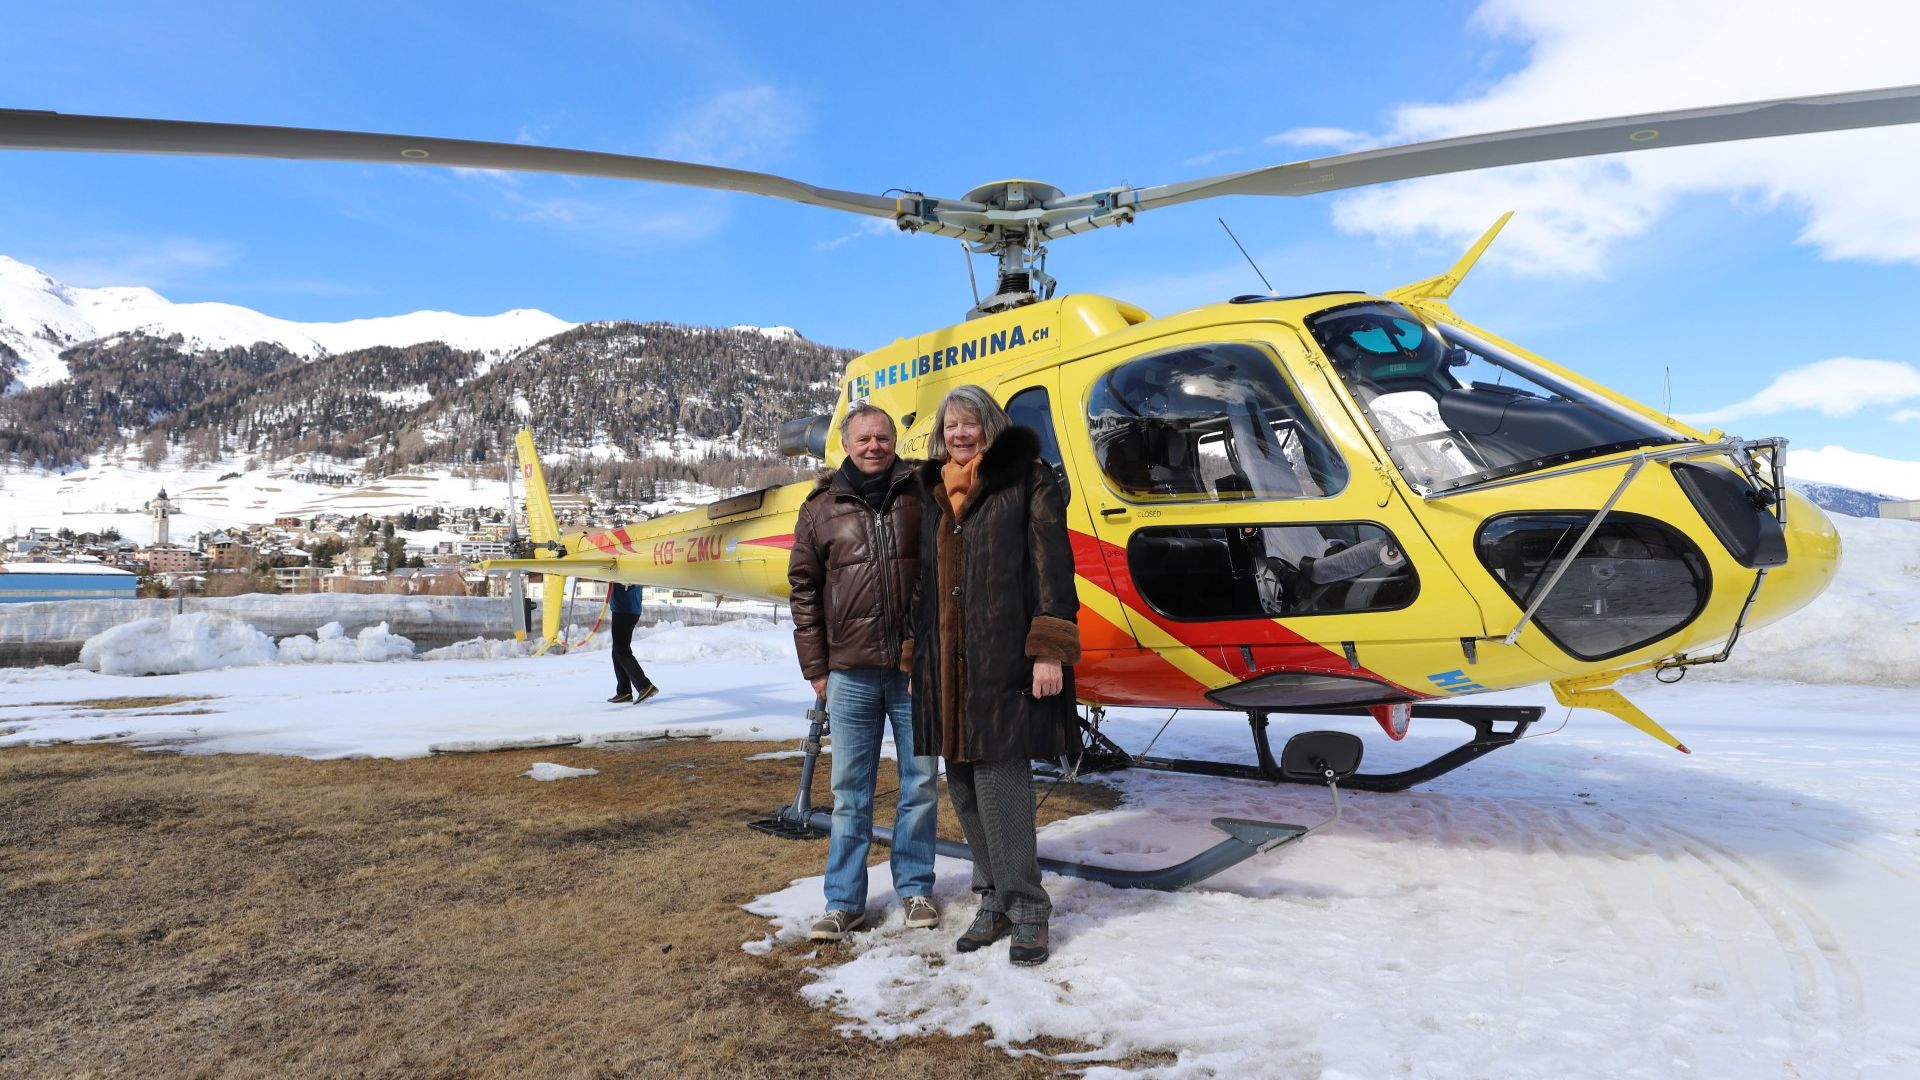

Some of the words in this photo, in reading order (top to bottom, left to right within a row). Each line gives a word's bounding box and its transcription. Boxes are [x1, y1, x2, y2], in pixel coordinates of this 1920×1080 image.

[874, 325, 1049, 388] HELIBERNINA.CH
[1137, 510, 1162, 518] CLOSED
[653, 535, 723, 565] HB-ZMU
